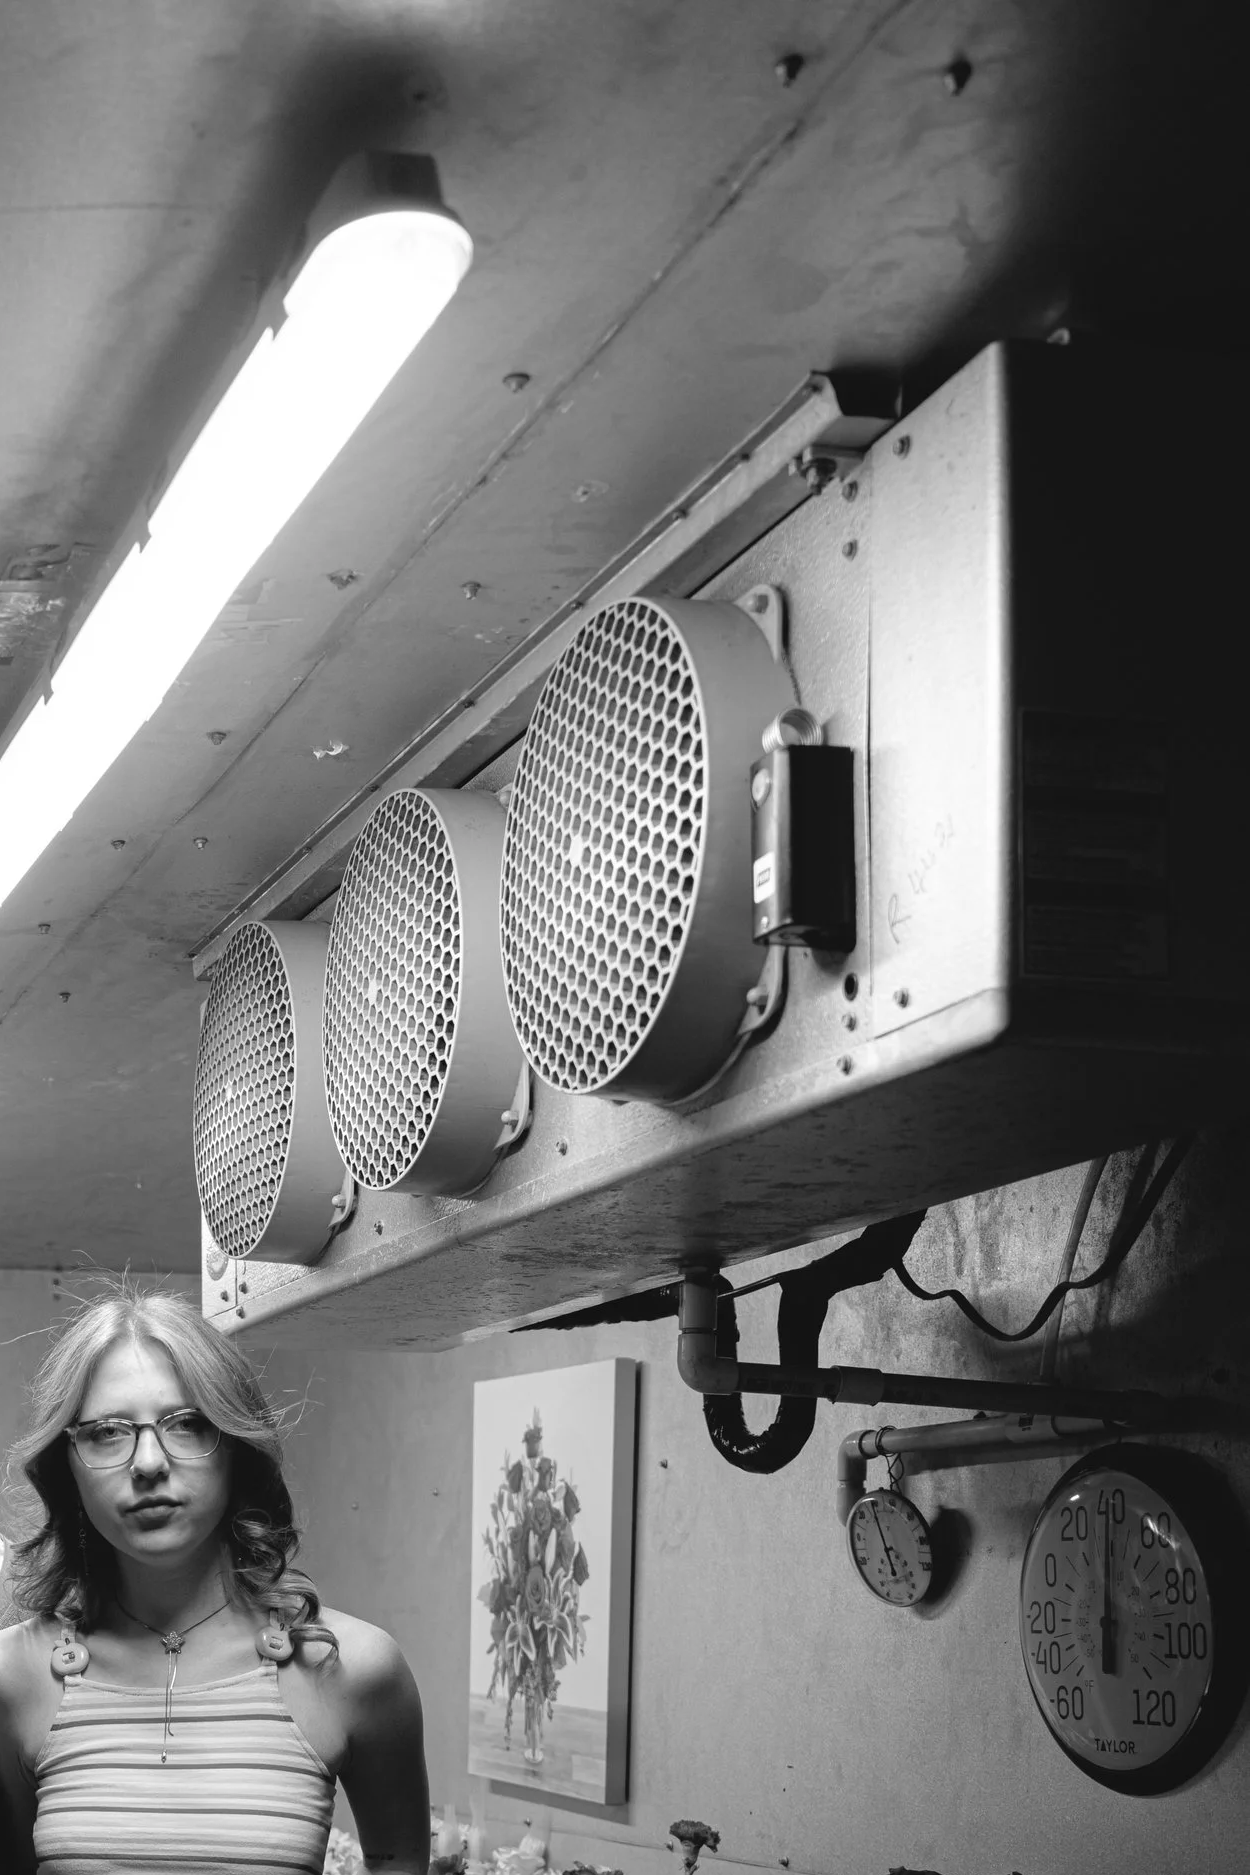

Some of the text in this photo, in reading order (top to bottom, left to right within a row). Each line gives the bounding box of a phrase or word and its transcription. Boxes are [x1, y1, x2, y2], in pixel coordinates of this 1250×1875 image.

[1061, 1505, 1088, 1542] 20
[1140, 1511, 1171, 1549] 60
[1044, 1553, 1057, 1587] 0
[1164, 1567, 1197, 1605] 80
[1026, 1600, 1056, 1635] -20
[1031, 1640, 1061, 1675] -40
[1164, 1622, 1208, 1660] 100
[1049, 1685, 1084, 1720] -60
[1132, 1689, 1176, 1727] 120
[1095, 1738, 1135, 1754] TAYLOR
